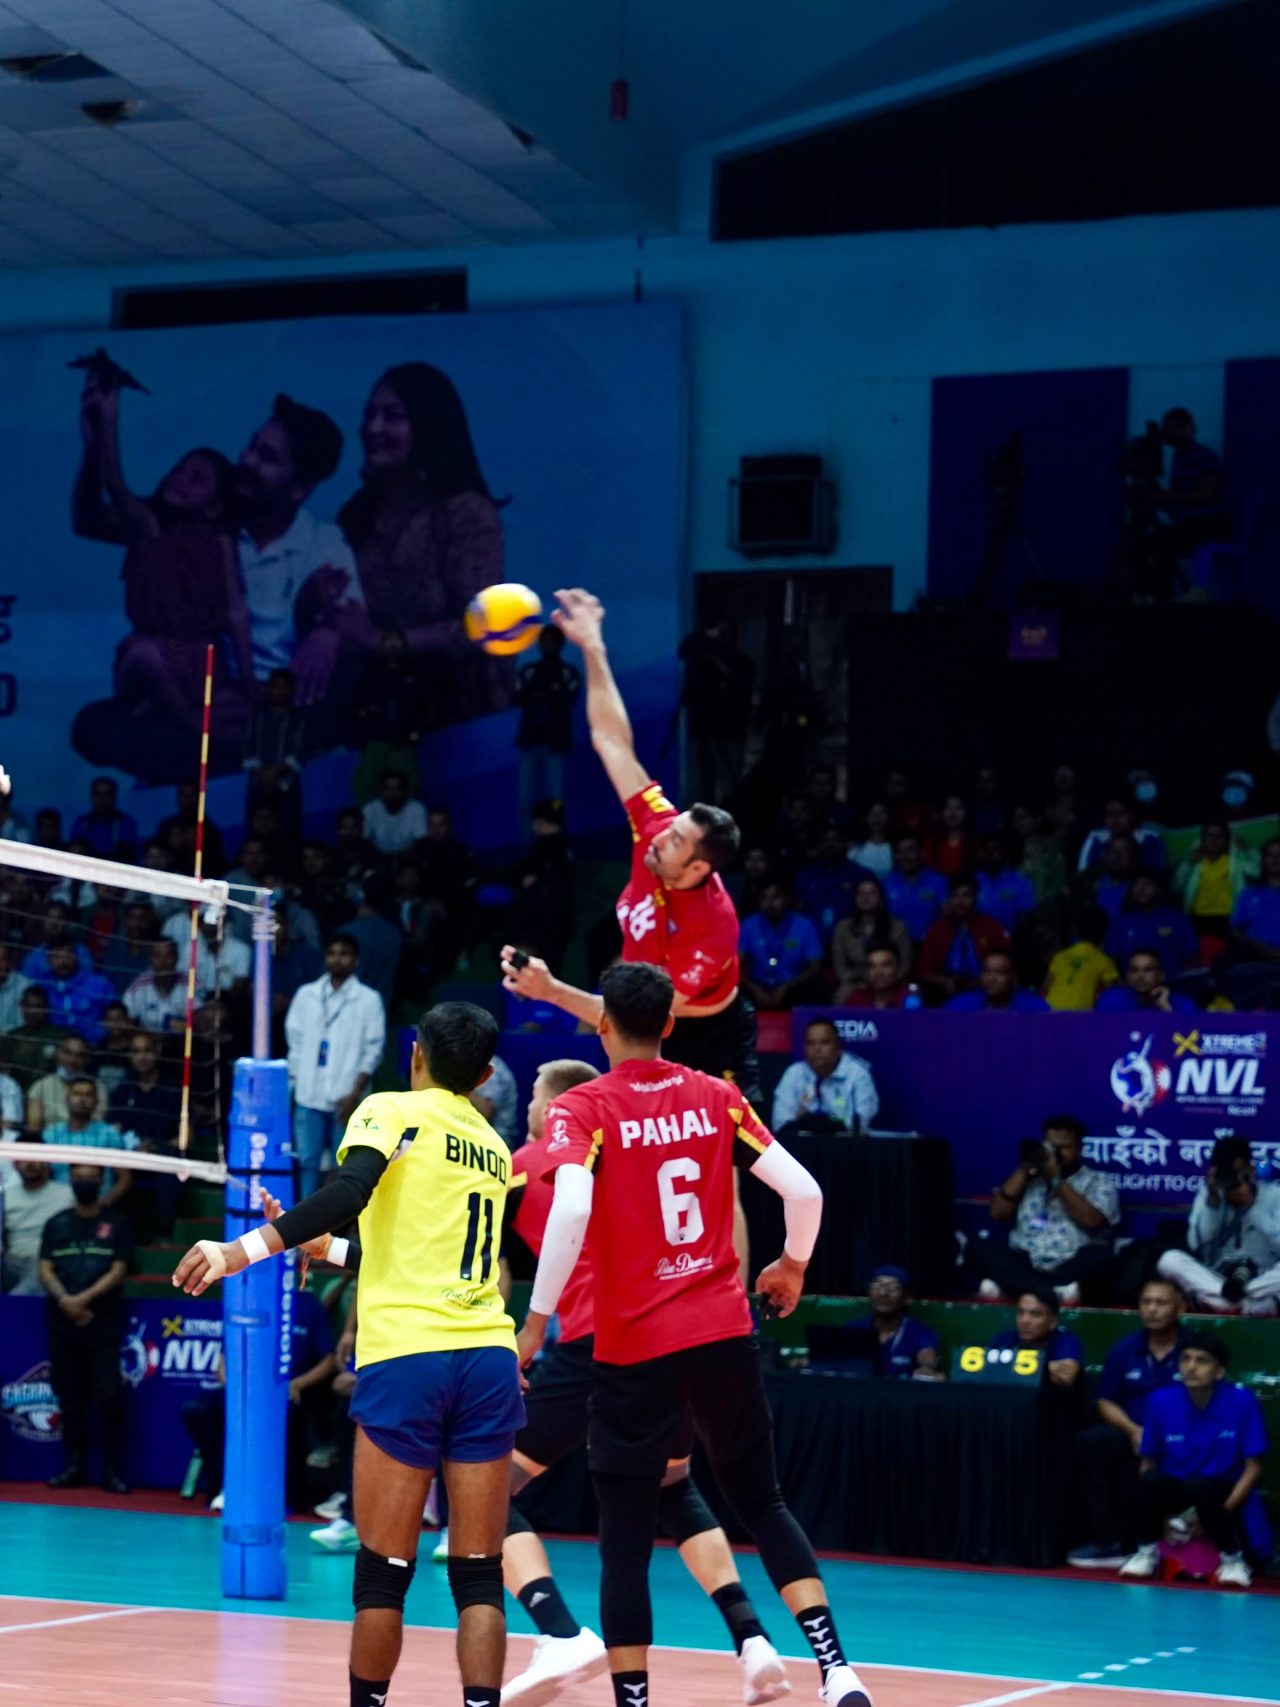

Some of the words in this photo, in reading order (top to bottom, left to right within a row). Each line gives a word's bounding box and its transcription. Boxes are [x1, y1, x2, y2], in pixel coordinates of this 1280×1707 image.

[833, 1019, 879, 1038] EDIA
[1175, 1058, 1266, 1096] NVL
[619, 1107, 718, 1149] PAHAL
[656, 1156, 705, 1246] 6
[460, 1191, 494, 1285] 11
[960, 1346, 986, 1373] 6
[1013, 1348, 1040, 1376] 5
